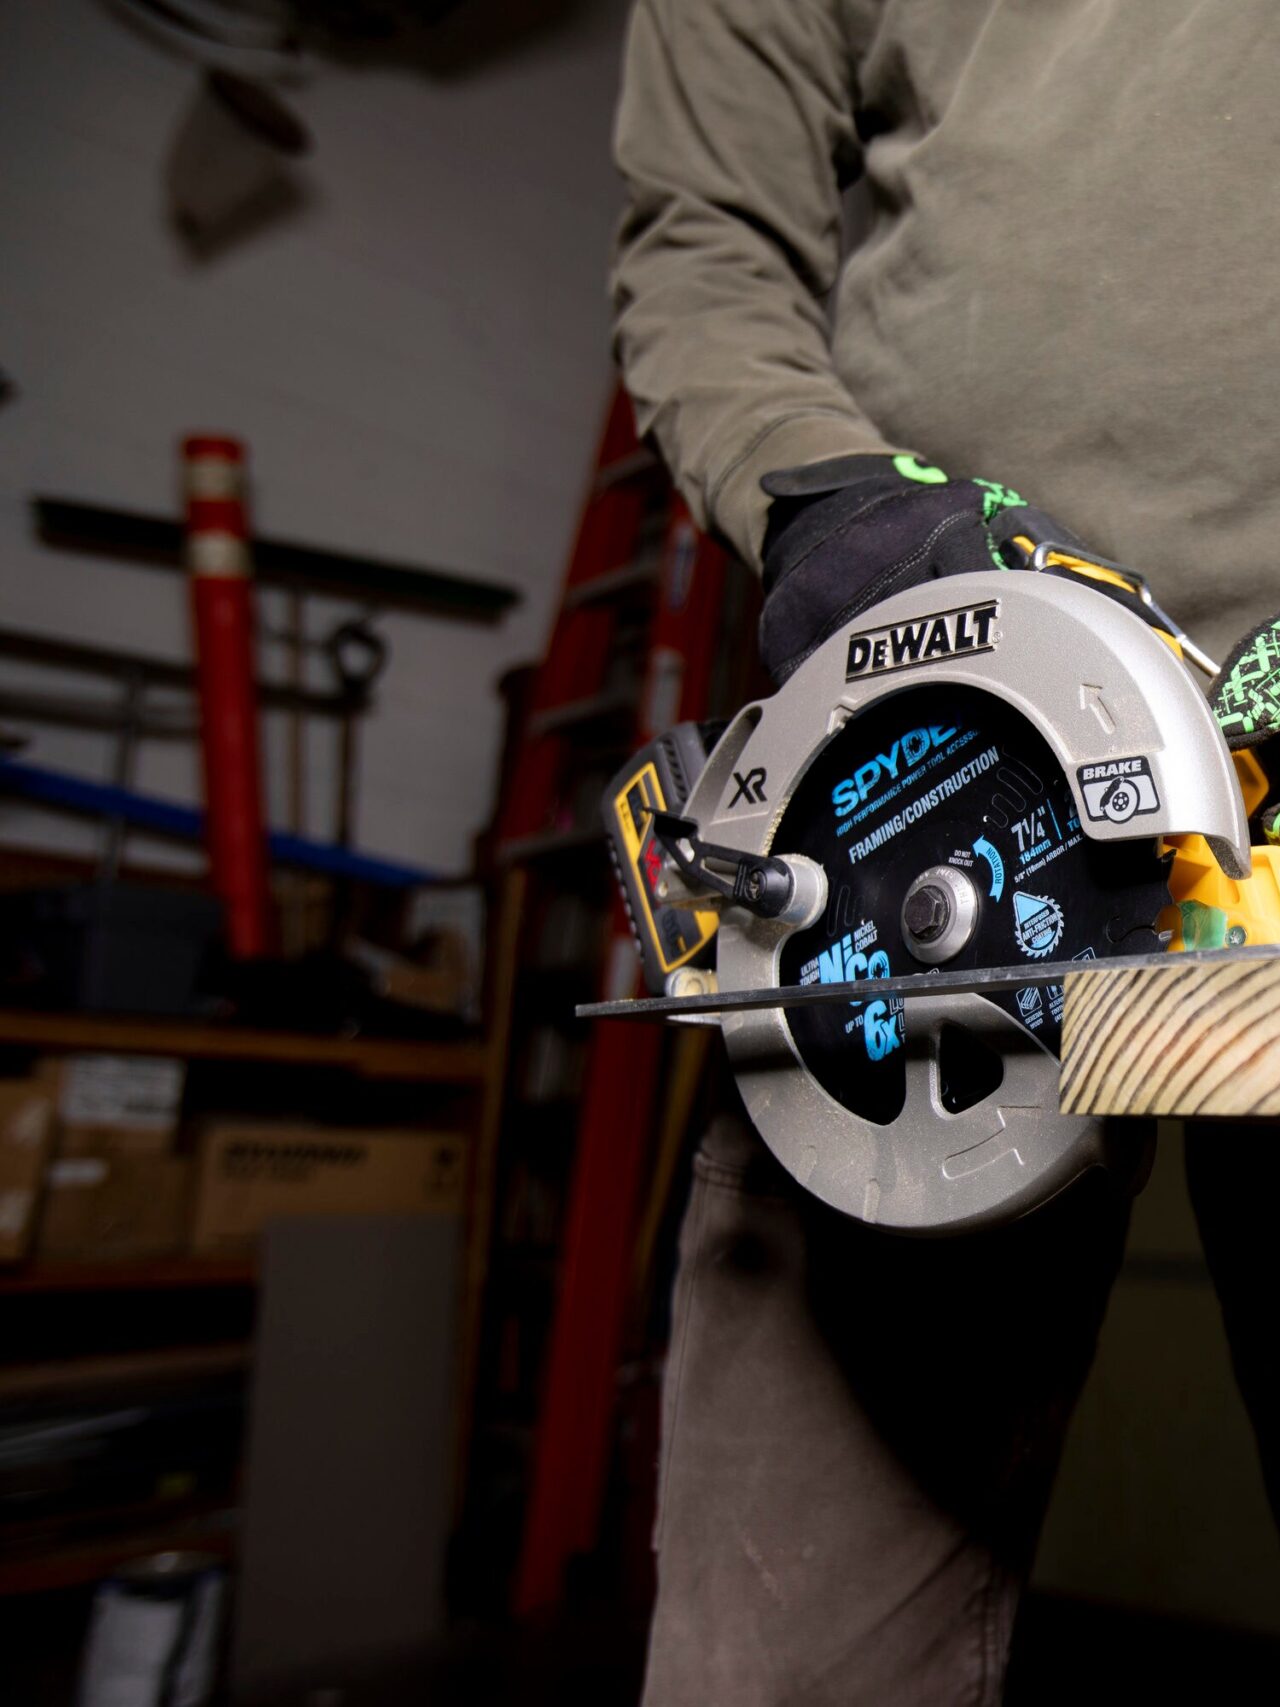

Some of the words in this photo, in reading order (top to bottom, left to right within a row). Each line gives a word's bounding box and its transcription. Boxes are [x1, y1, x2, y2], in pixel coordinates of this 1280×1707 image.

[846, 606, 998, 674] DEWALT
[832, 723, 961, 817] SPYDE
[901, 767, 927, 788] POWER
[928, 751, 946, 770] TOOL
[1083, 760, 1142, 780] BRAKE
[728, 767, 767, 809] XR
[849, 746, 1000, 864] FRAMING/CONSTRUCTION
[963, 859, 974, 867] OUT
[1019, 839, 1051, 865] 184mm
[1046, 846, 1065, 862] ARBOR
[986, 847, 1003, 884] ROTATION
[854, 920, 876, 940] NICKEL
[855, 930, 878, 952] COBALT
[845, 1021, 855, 1034] UP
[854, 1014, 864, 1027] TO
